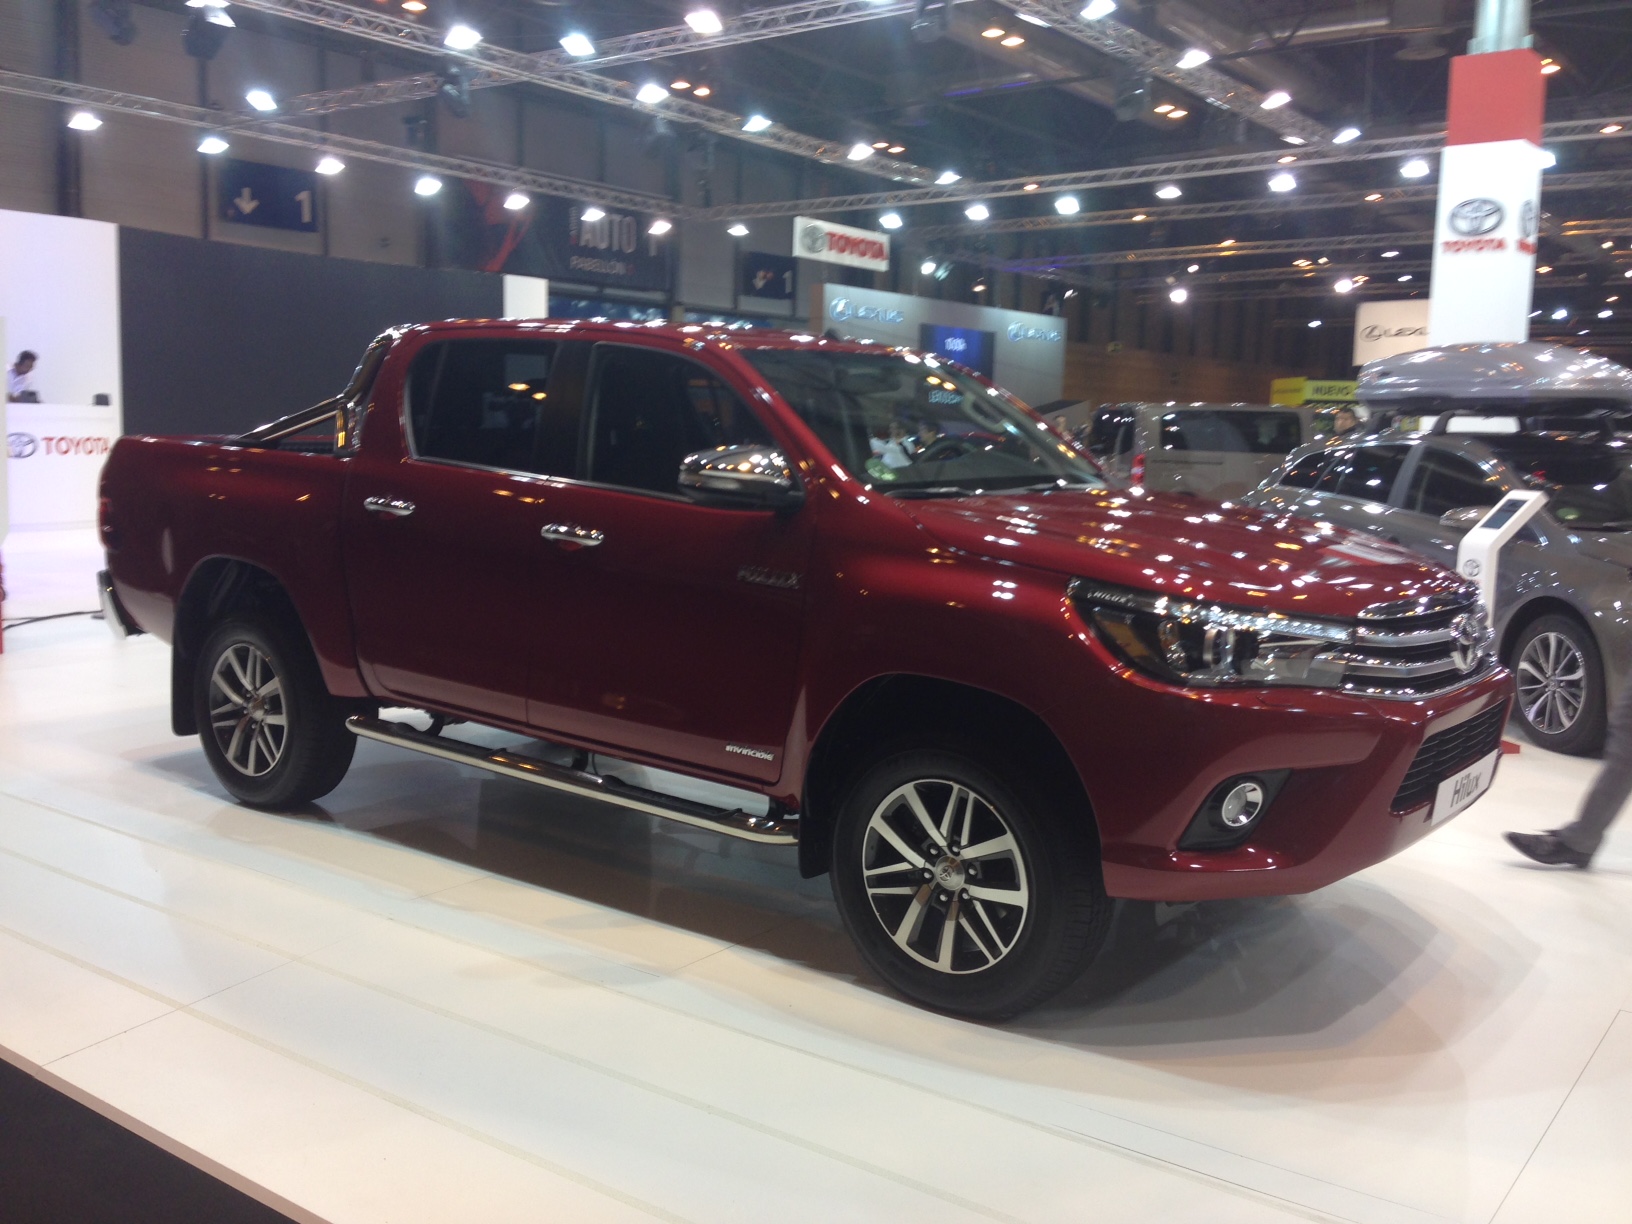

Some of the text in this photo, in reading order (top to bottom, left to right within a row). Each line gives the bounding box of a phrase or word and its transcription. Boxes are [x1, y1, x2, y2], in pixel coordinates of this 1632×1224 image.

[294, 190, 313, 224] 1
[580, 211, 636, 253] AUTO
[825, 231, 889, 261] TOYOTA
[1440, 237, 1508, 253] TOYOTA
[782, 269, 793, 294] 1
[852, 304, 905, 324] LEXUS
[1022, 327, 1063, 343] LEXUS
[1384, 326, 1429, 338] LEX
[41, 435, 110, 455] TOYOTA
[725, 744, 775, 761] invincible
[1450, 772, 1482, 808] Hilux
